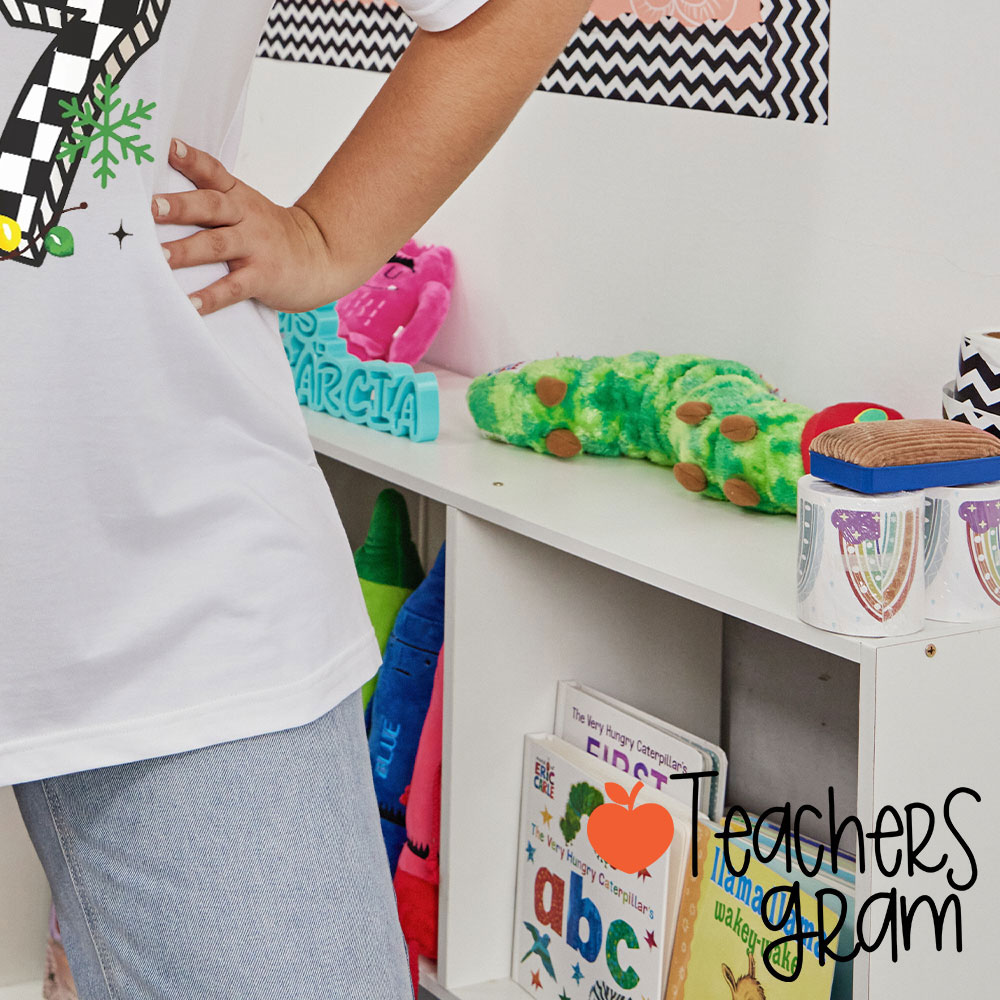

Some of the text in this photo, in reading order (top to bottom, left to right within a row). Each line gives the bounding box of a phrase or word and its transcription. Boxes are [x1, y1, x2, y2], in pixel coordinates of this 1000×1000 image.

[290, 350, 419, 437] ARCIA
[534, 761, 556, 786] ERIC
[572, 706, 688, 775] The Very Hungry Caterpillar's
[533, 776, 555, 800] CARLE
[531, 822, 655, 920] The Very Hungry Caterpillar's
[533, 867, 640, 990] abc
